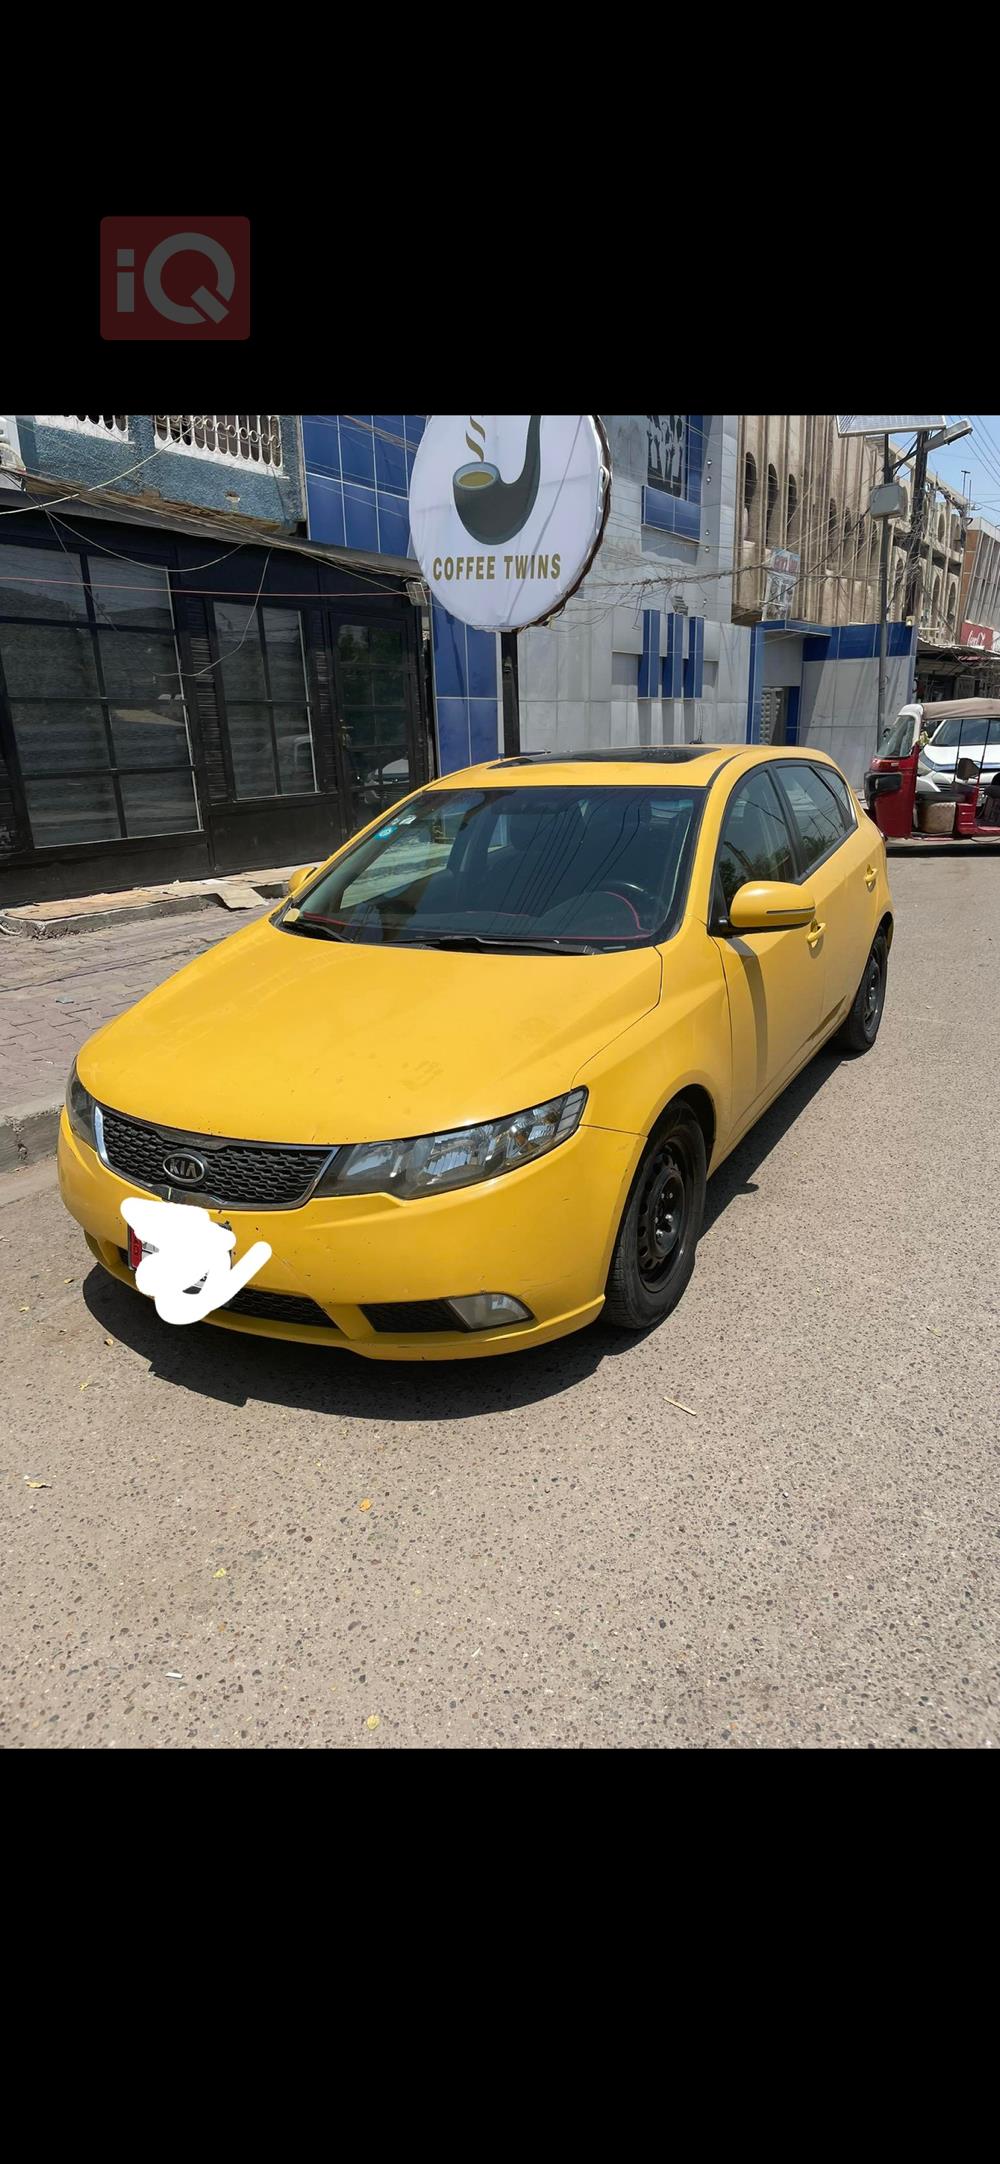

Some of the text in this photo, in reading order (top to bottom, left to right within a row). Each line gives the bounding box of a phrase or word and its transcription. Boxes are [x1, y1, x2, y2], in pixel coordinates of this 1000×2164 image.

[433, 553, 561, 581] COFFEE TWINS
[170, 1159, 197, 1177] KIA
